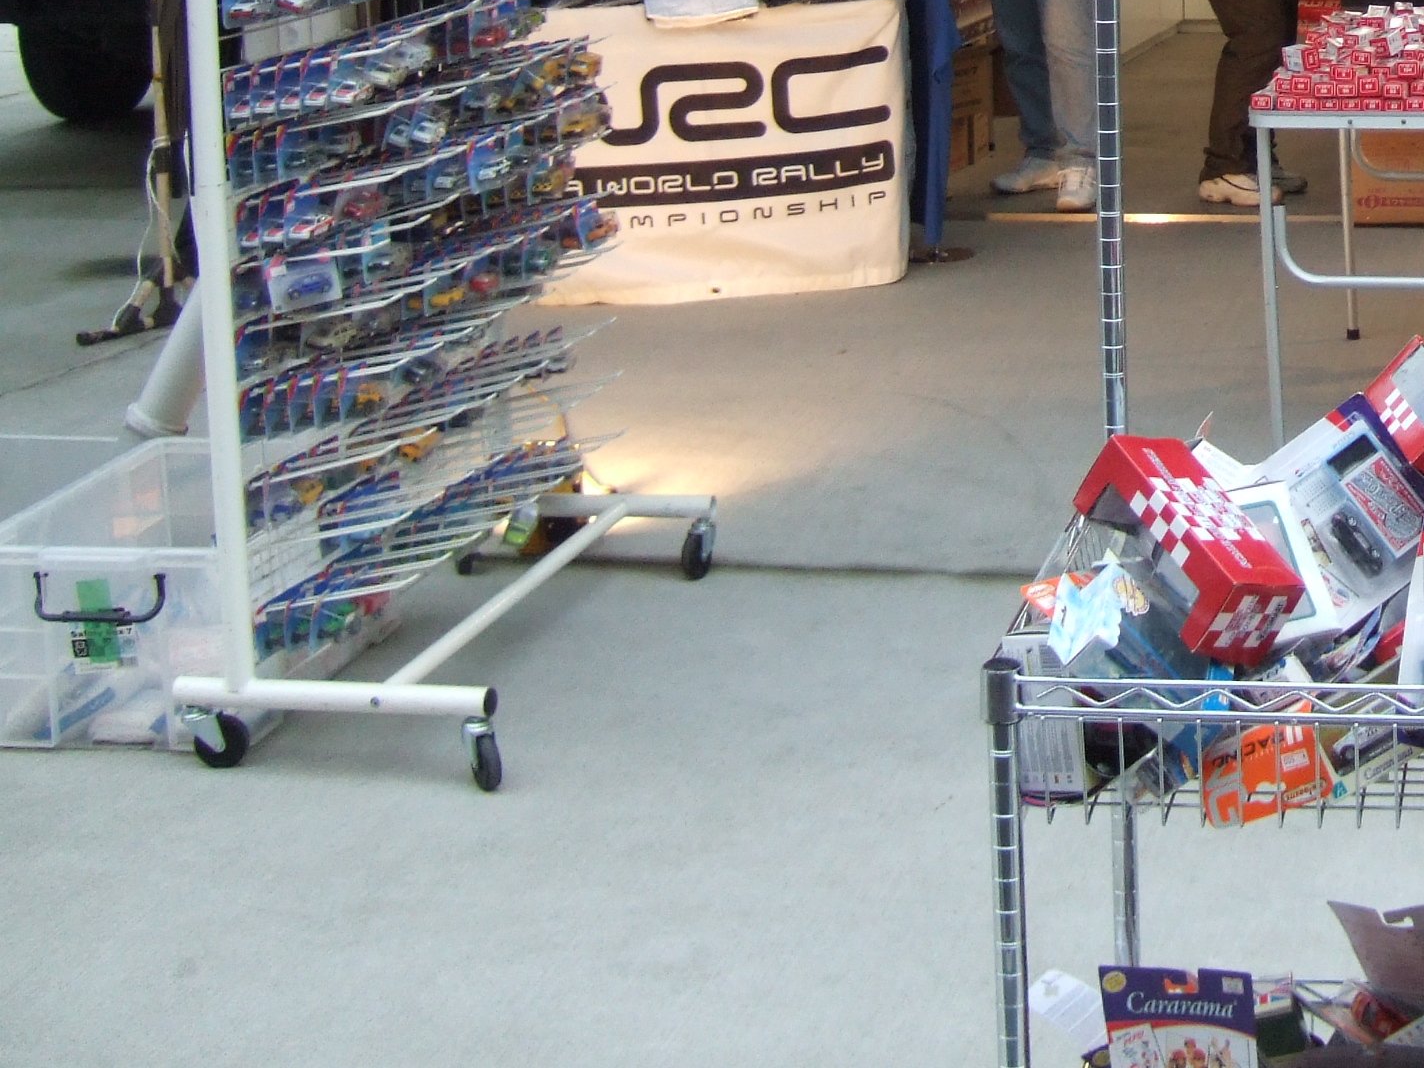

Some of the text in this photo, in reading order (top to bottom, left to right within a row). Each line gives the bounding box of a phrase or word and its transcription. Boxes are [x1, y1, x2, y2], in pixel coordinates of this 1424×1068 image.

[752, 152, 885, 185] RALLY
[630, 190, 888, 229] MPIONSHIP
[1126, 990, 1234, 1018] Cararama
